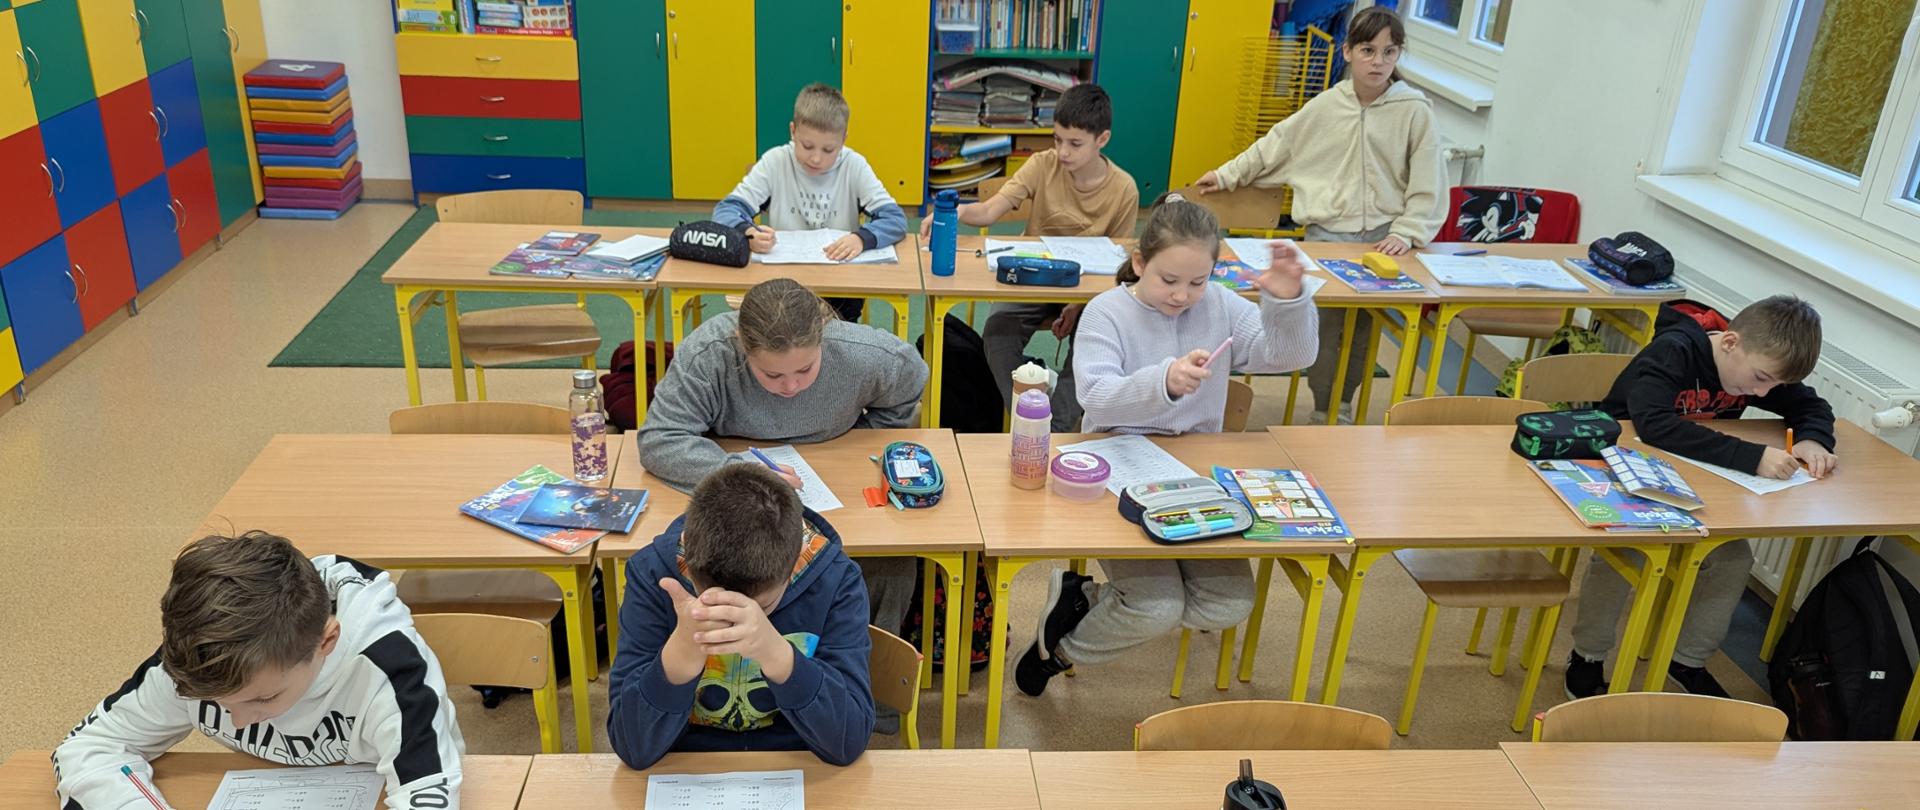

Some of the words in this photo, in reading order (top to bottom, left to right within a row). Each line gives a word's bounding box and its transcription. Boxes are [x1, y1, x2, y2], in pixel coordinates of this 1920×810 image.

[279, 64, 315, 72] 4
[682, 230, 727, 249] NASA
[409, 777, 449, 810] YO
